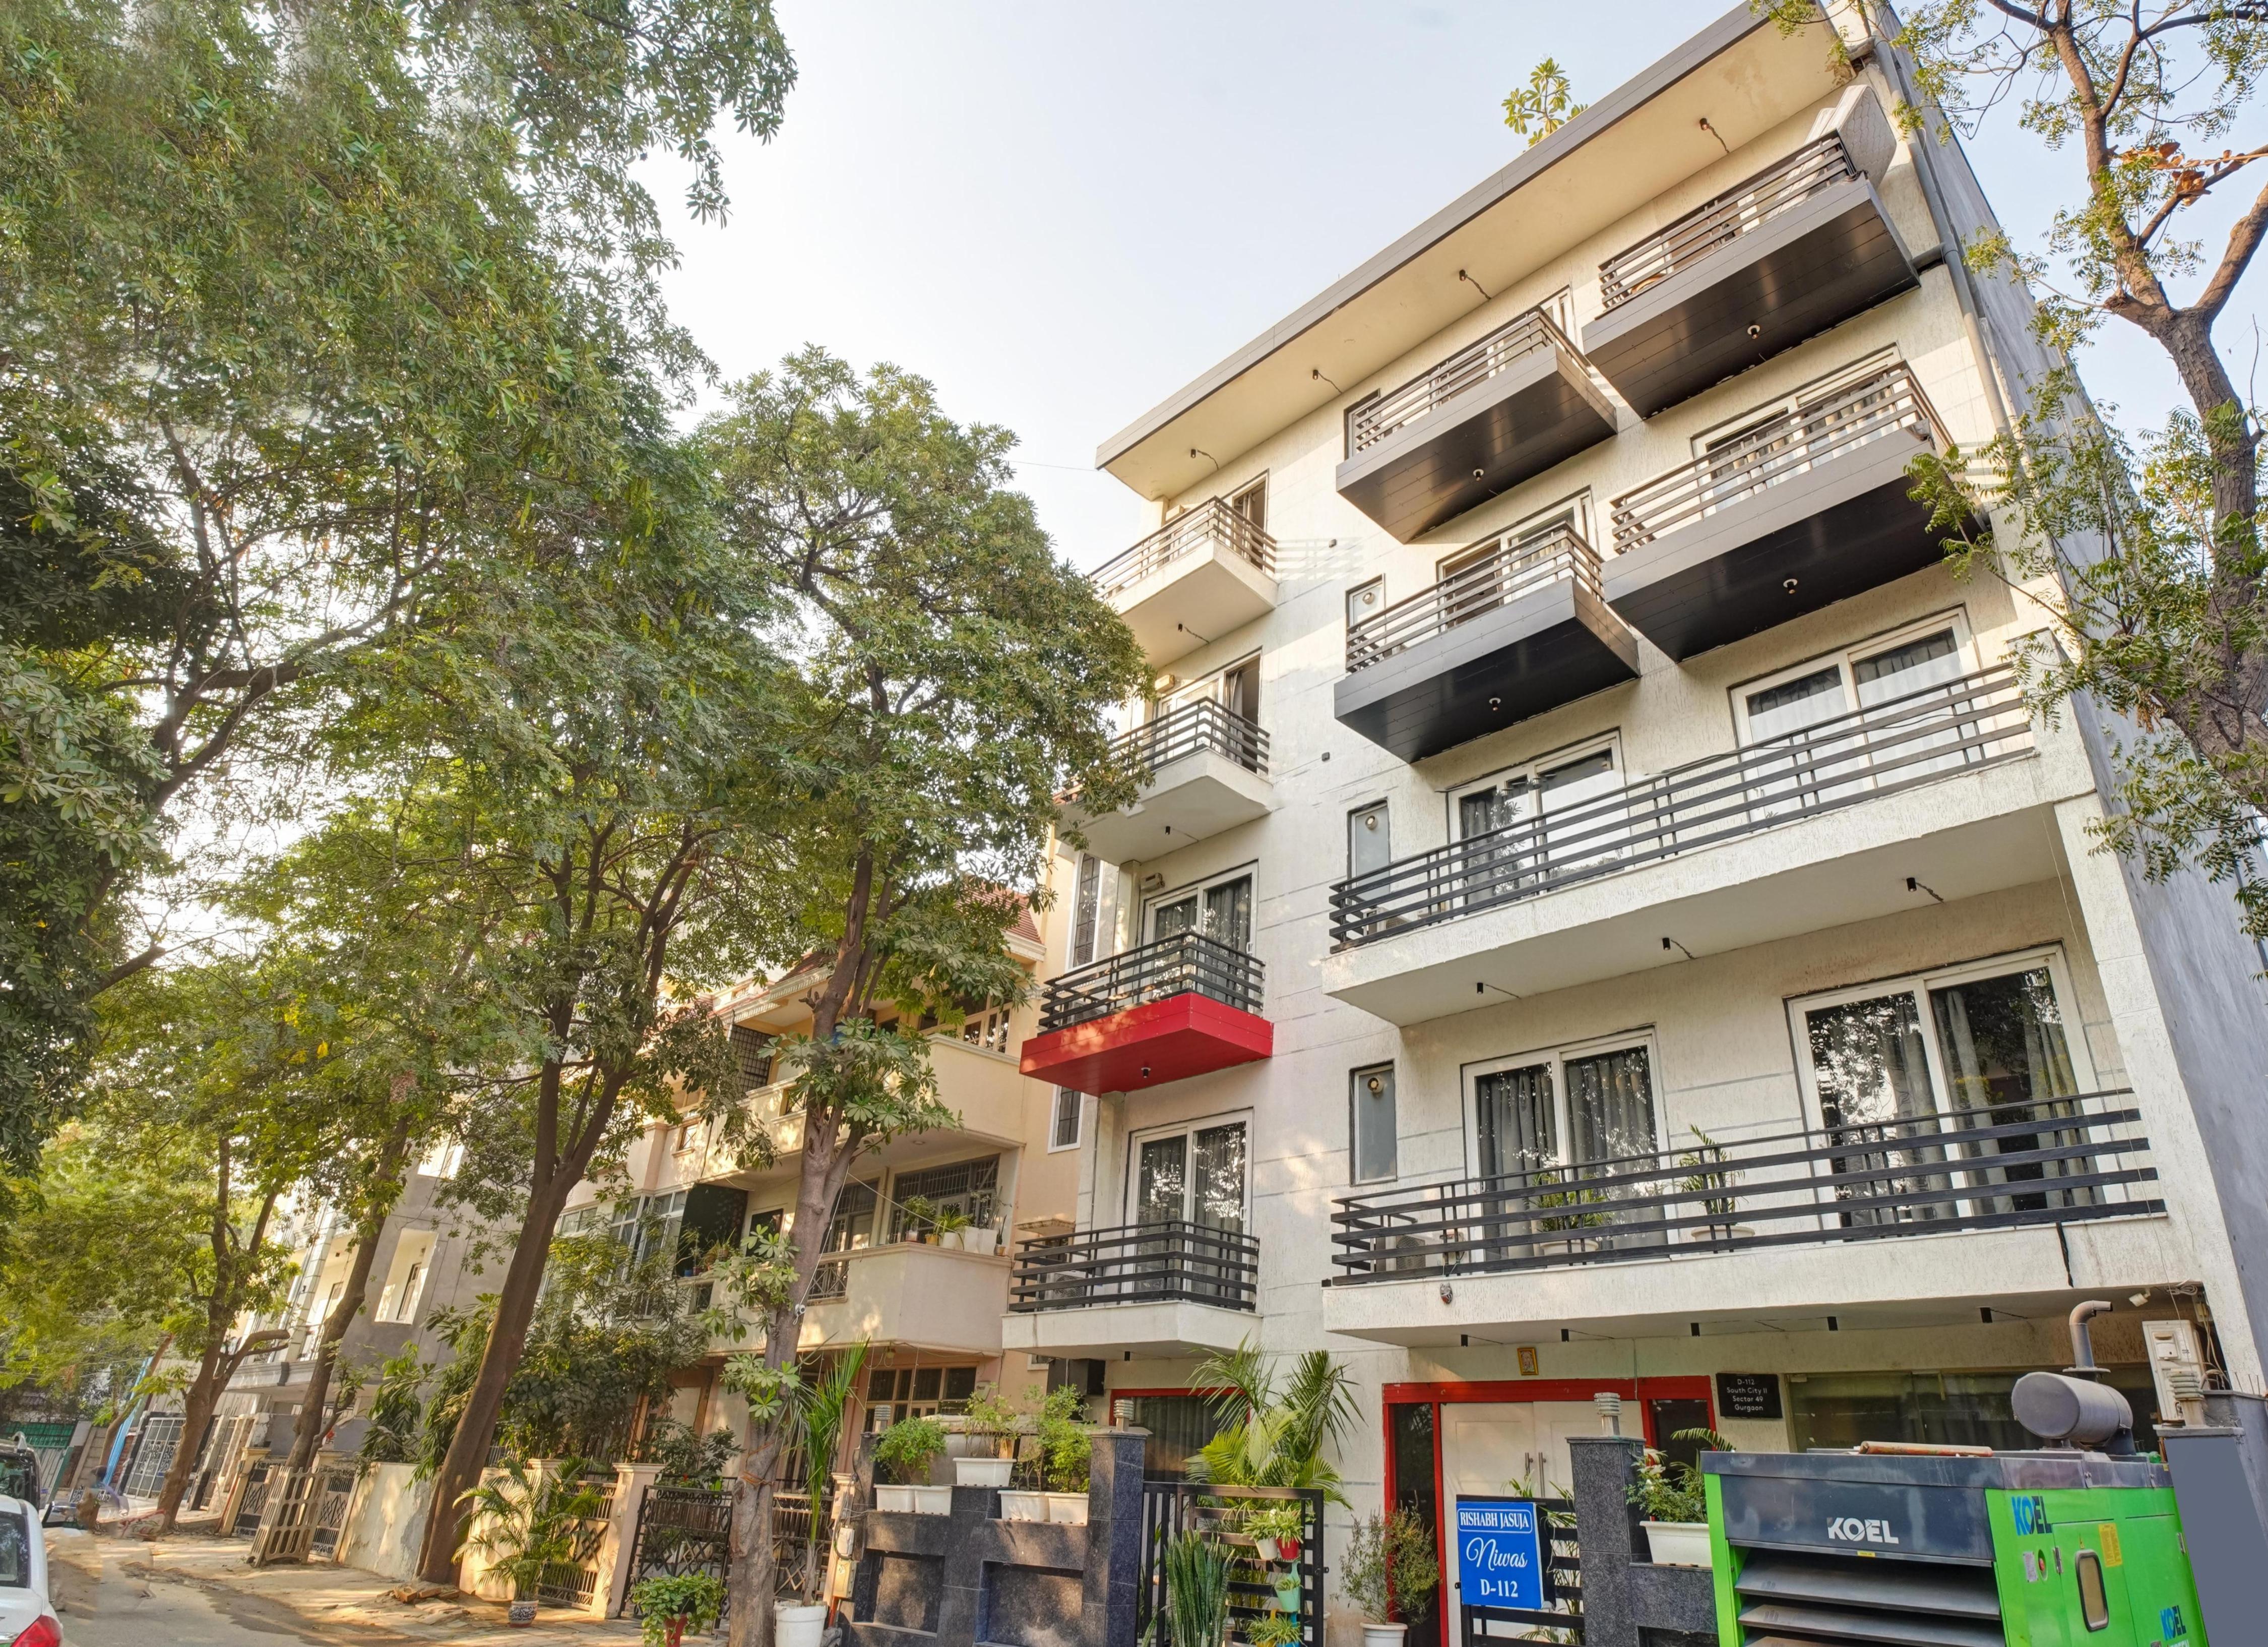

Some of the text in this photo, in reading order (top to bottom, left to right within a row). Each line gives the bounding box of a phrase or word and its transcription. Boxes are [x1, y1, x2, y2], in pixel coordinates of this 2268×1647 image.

[1747, 1387, 1761, 1395] City
[1734, 1404, 1763, 1412] Gurgaon
[1460, 1511, 1529, 1530] RISHABH JASUJA
[2011, 1496, 2053, 1536] KOEL
[1826, 1517, 1899, 1544] KOEL
[1466, 1537, 1528, 1571] Niwas
[1480, 1578, 1519, 1597] D-112
[2160, 1605, 2186, 1640] KOEL
